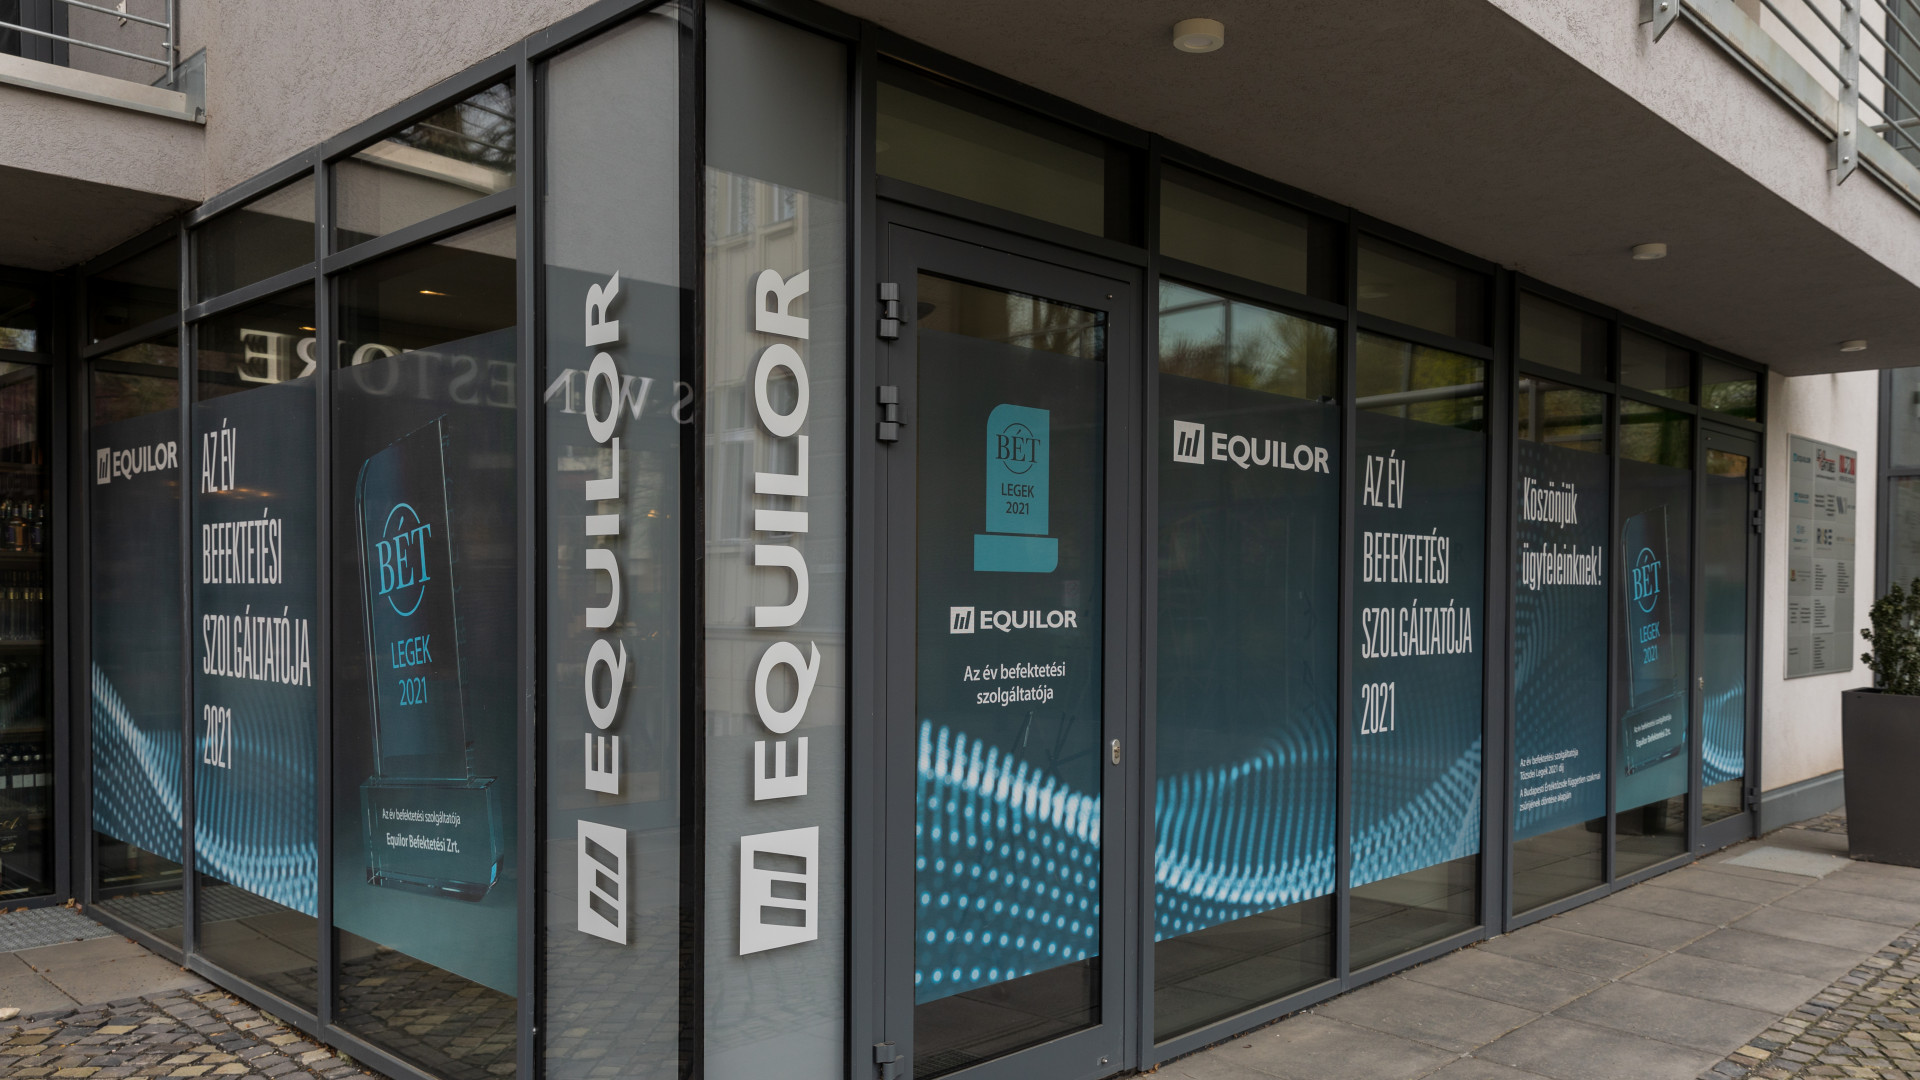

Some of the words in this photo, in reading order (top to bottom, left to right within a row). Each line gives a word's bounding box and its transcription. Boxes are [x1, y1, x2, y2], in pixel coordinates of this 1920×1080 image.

[112, 440, 178, 480] EQUILOR
[202, 431, 219, 494] AZ
[220, 417, 236, 492] ÉV
[995, 429, 1041, 463] BÉT
[1211, 431, 1330, 474] EQUILOR
[1001, 482, 1035, 499] LEGEK
[1363, 454, 1384, 507] AZ
[1387, 449, 1406, 509] ÉV
[1005, 501, 1030, 515] 2021
[1523, 476, 1578, 529] Köszönjük
[203, 507, 282, 584] BEFEKTETÉSI
[584, 269, 627, 795] EQUILOR
[754, 269, 821, 801] EQUILOR
[375, 516, 432, 596] BÉT
[1363, 527, 1450, 584] BEFEKTETÉSI
[1522, 542, 1602, 591] ügyfeleinknek!
[1632, 555, 1662, 601] BÉT
[980, 609, 1078, 633] EQUILOR
[1361, 598, 1473, 659] SZOLGÁLTATÓJA
[1639, 621, 1661, 644] LEGEK
[203, 604, 312, 688] SZOLGÁLTATÓJA
[391, 633, 433, 670] LEGEK
[1643, 644, 1659, 664] 2021
[399, 675, 429, 706] 2021
[963, 665, 981, 682] Az
[982, 664, 998, 681] év
[1000, 661, 1066, 680] befektetési
[976, 685, 1054, 707] szolgáltatója
[1361, 681, 1396, 735] 2021
[203, 703, 232, 770] 2021
[382, 808, 389, 819] Az
[390, 808, 396, 820] év
[395, 808, 425, 822] befektetési
[424, 810, 461, 828] szolgáltatója
[386, 832, 409, 849] Equilor
[408, 834, 446, 852] Befektetési
[446, 838, 460, 853] Zrt.
